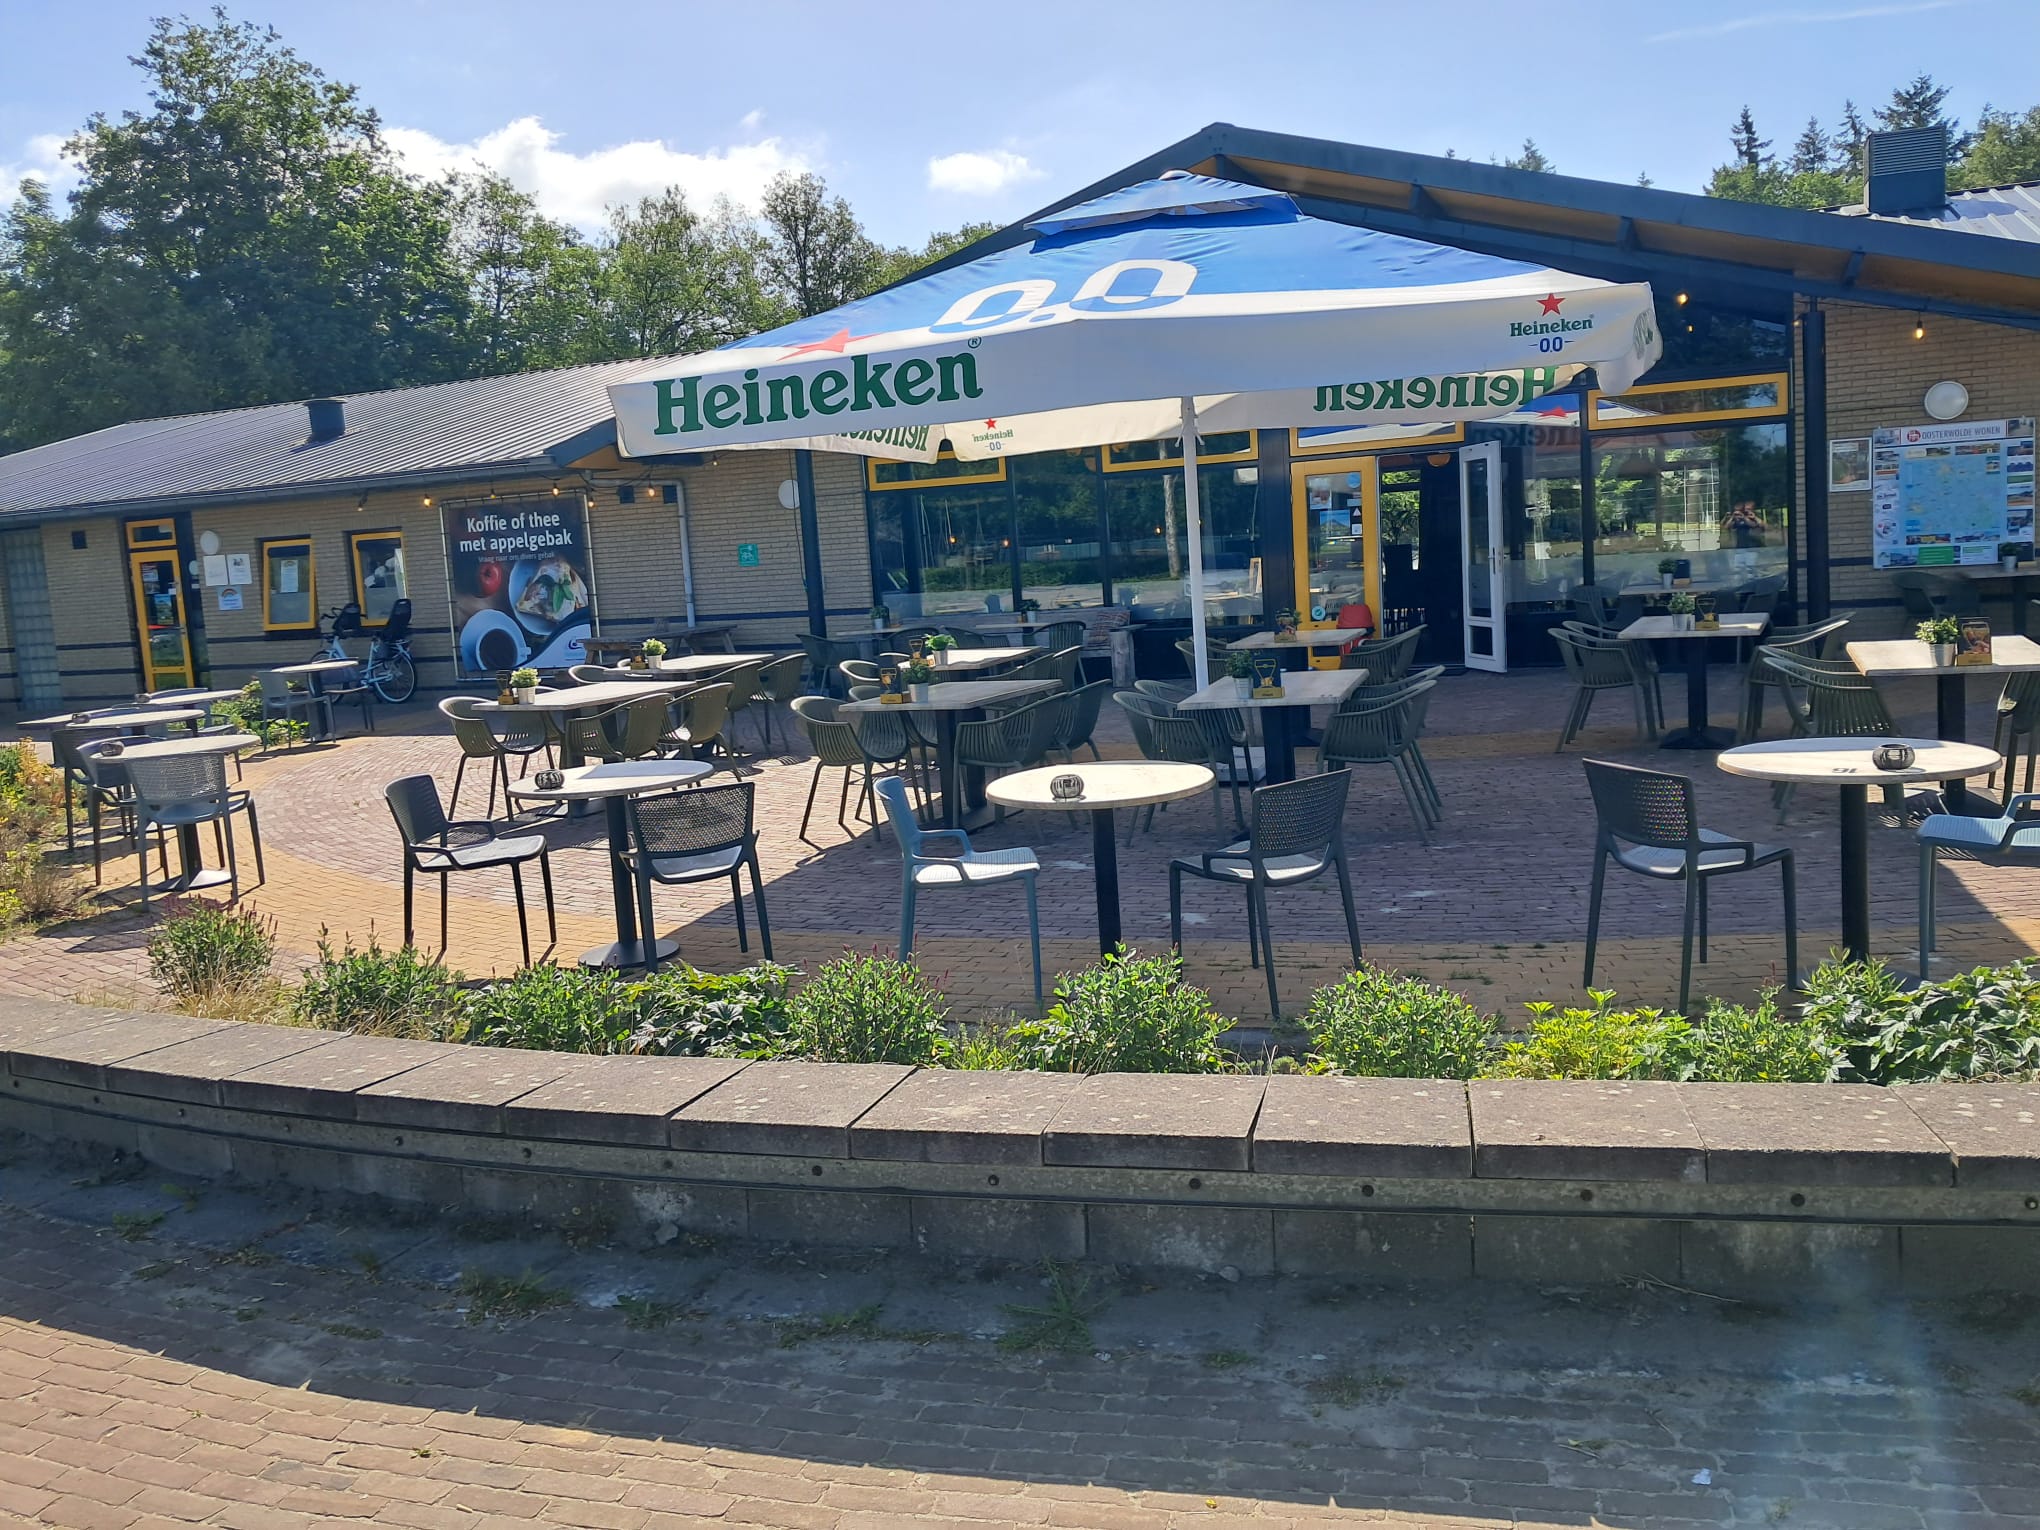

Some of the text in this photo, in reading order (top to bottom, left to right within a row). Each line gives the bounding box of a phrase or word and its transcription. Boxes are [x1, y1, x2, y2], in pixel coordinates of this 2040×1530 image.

[929, 259, 1198, 333] 0.0
[1922, 426, 2001, 440] OOSTERWOLDE WONEN
[467, 511, 560, 533] Koffie of thee
[460, 528, 573, 553] met appelgebak
